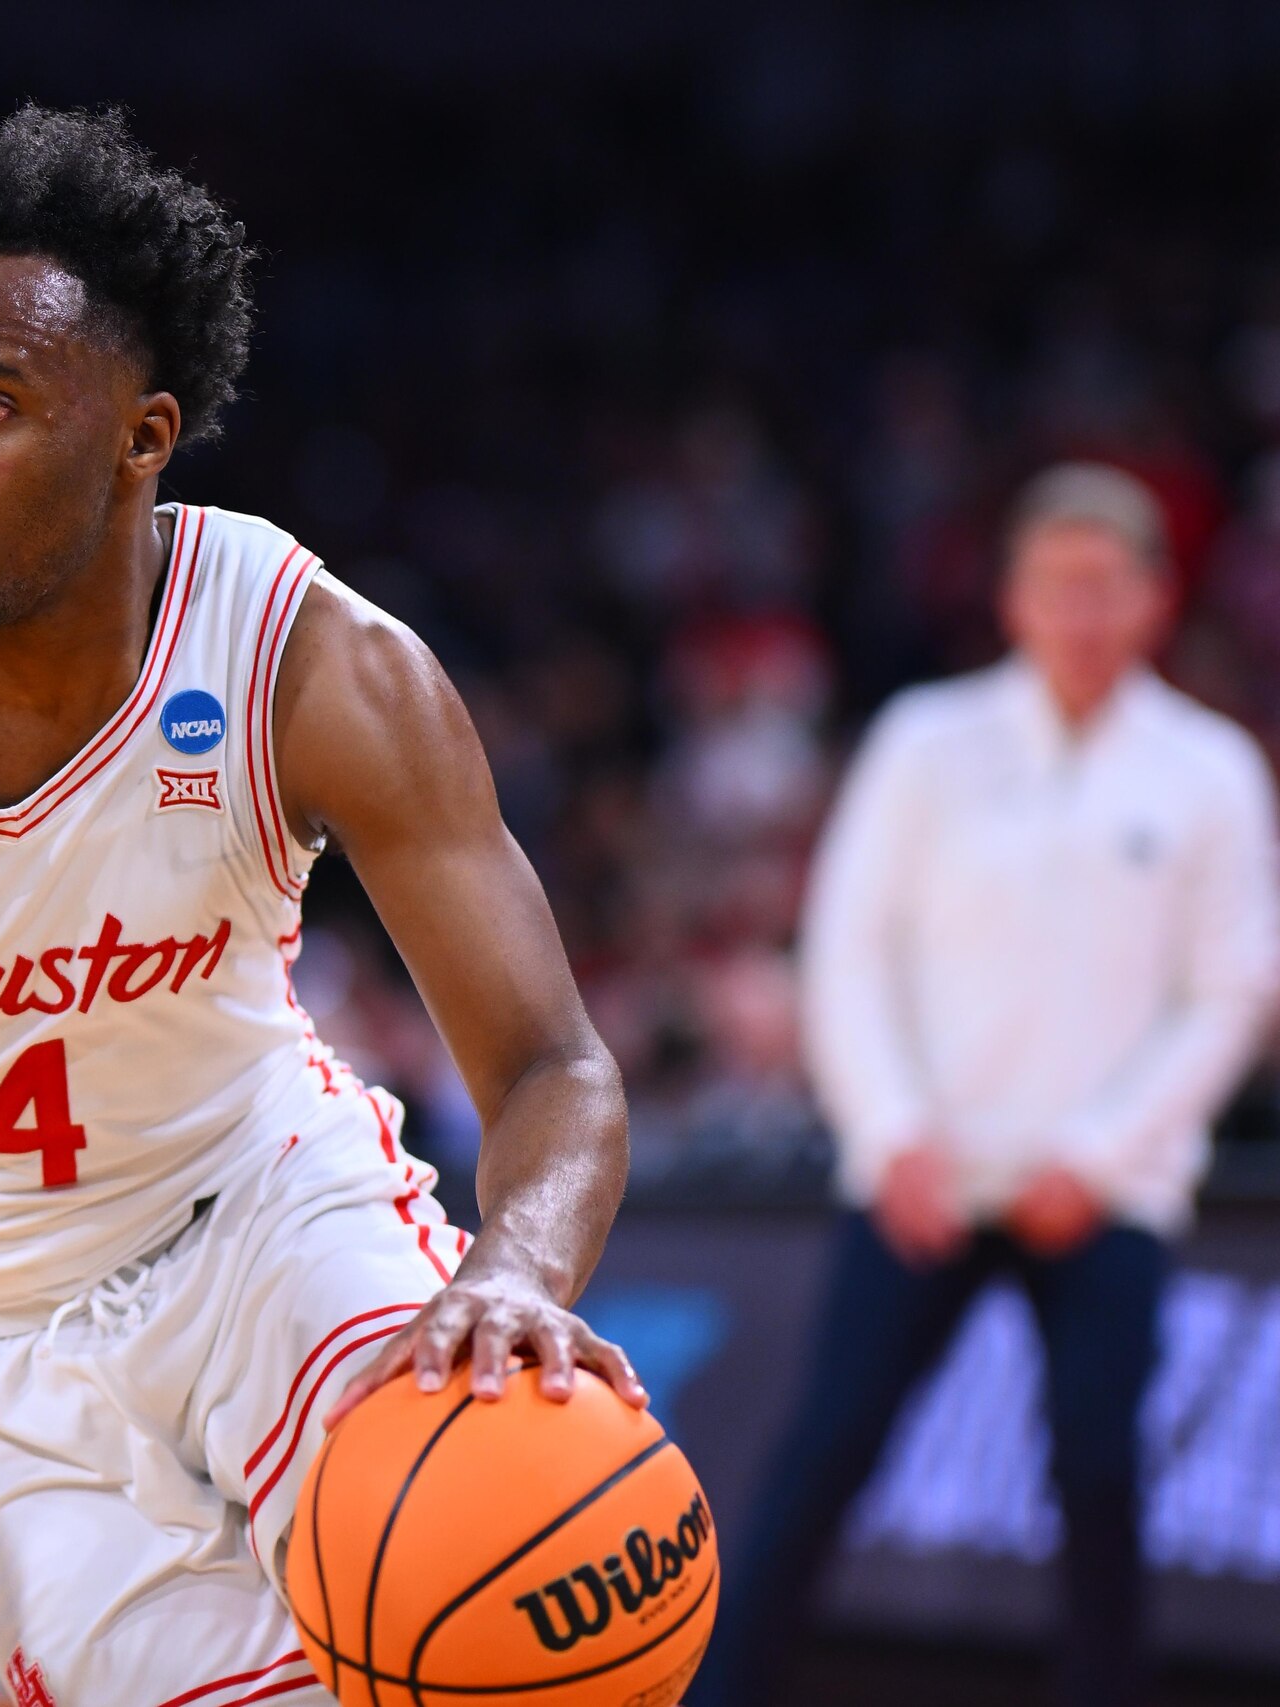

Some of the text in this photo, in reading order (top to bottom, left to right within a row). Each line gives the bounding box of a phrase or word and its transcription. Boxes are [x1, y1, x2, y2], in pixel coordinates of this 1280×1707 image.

[171, 719, 222, 739] NCAA
[162, 776, 216, 802] XII
[513, 1491, 711, 1653] Wilson
